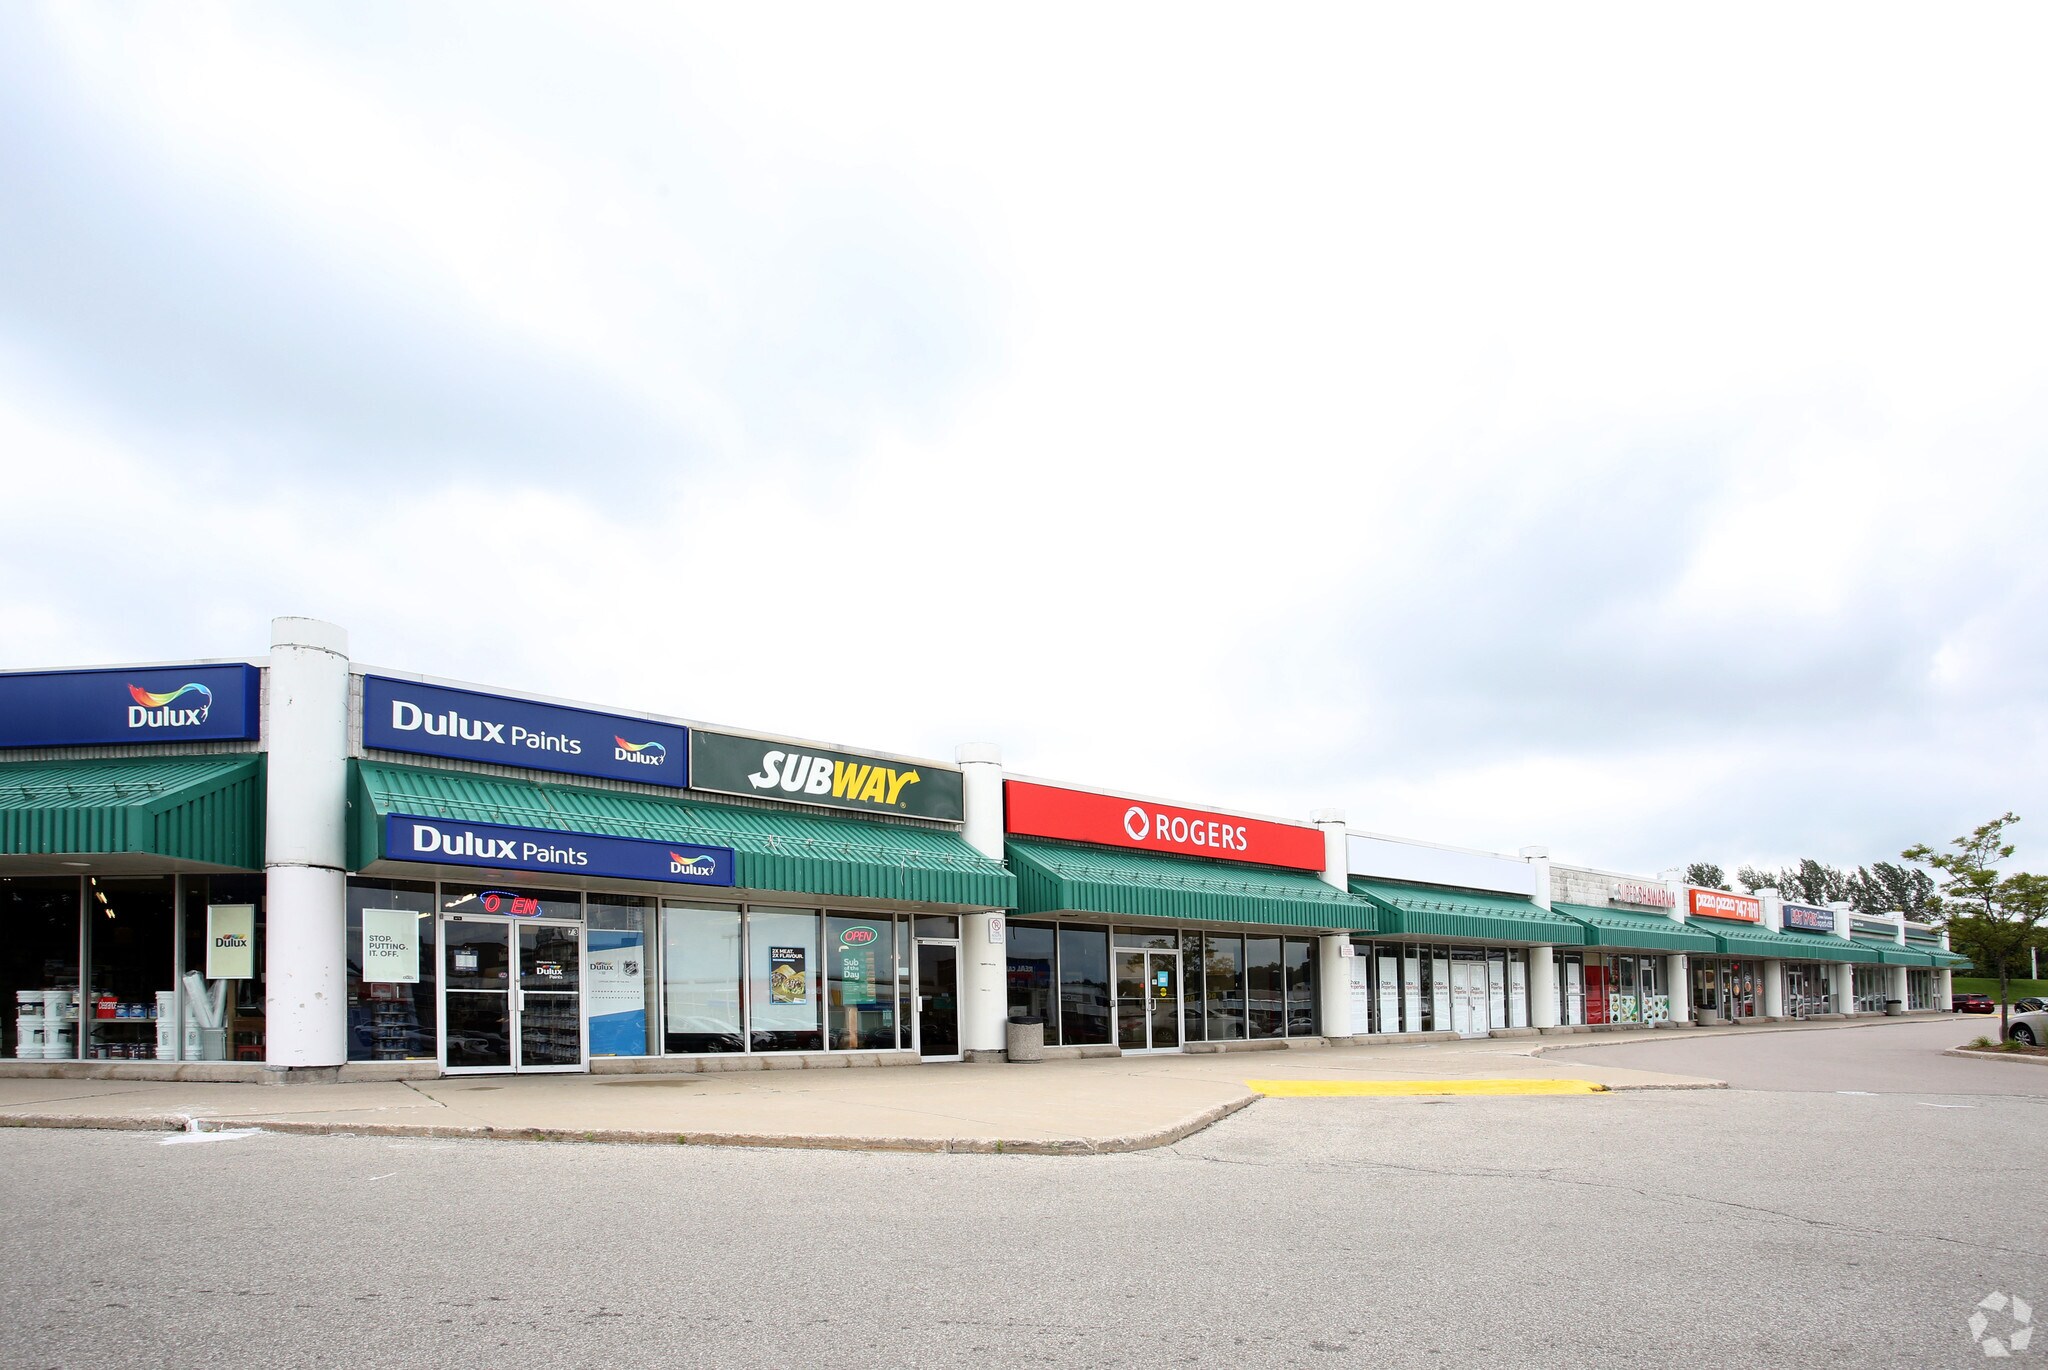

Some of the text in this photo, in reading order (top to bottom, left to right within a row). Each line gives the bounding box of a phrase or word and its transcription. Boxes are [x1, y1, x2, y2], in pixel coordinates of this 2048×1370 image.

[128, 706, 200, 727] Dulux
[392, 700, 582, 755] Dulux Paints
[614, 747, 660, 766] Dulux
[748, 750, 921, 805] SUBWAY
[1155, 813, 1248, 851] ROGERS
[413, 824, 588, 866] Dulux Paints
[670, 861, 710, 876] Dulux
[1638, 886, 1676, 909] SHAWARMA
[1696, 893, 1716, 911] pizza
[1716, 896, 1735, 914] pizza
[215, 937, 247, 947] Dulux
[844, 930, 873, 942] OPEN
[369, 942, 409, 951] PUTTING.
[380, 950, 399, 958] OFF.
[590, 963, 614, 971] Dulux
[843, 958, 859, 966] Sub
[536, 967, 563, 975] Dulux
[843, 970, 860, 980] Day
